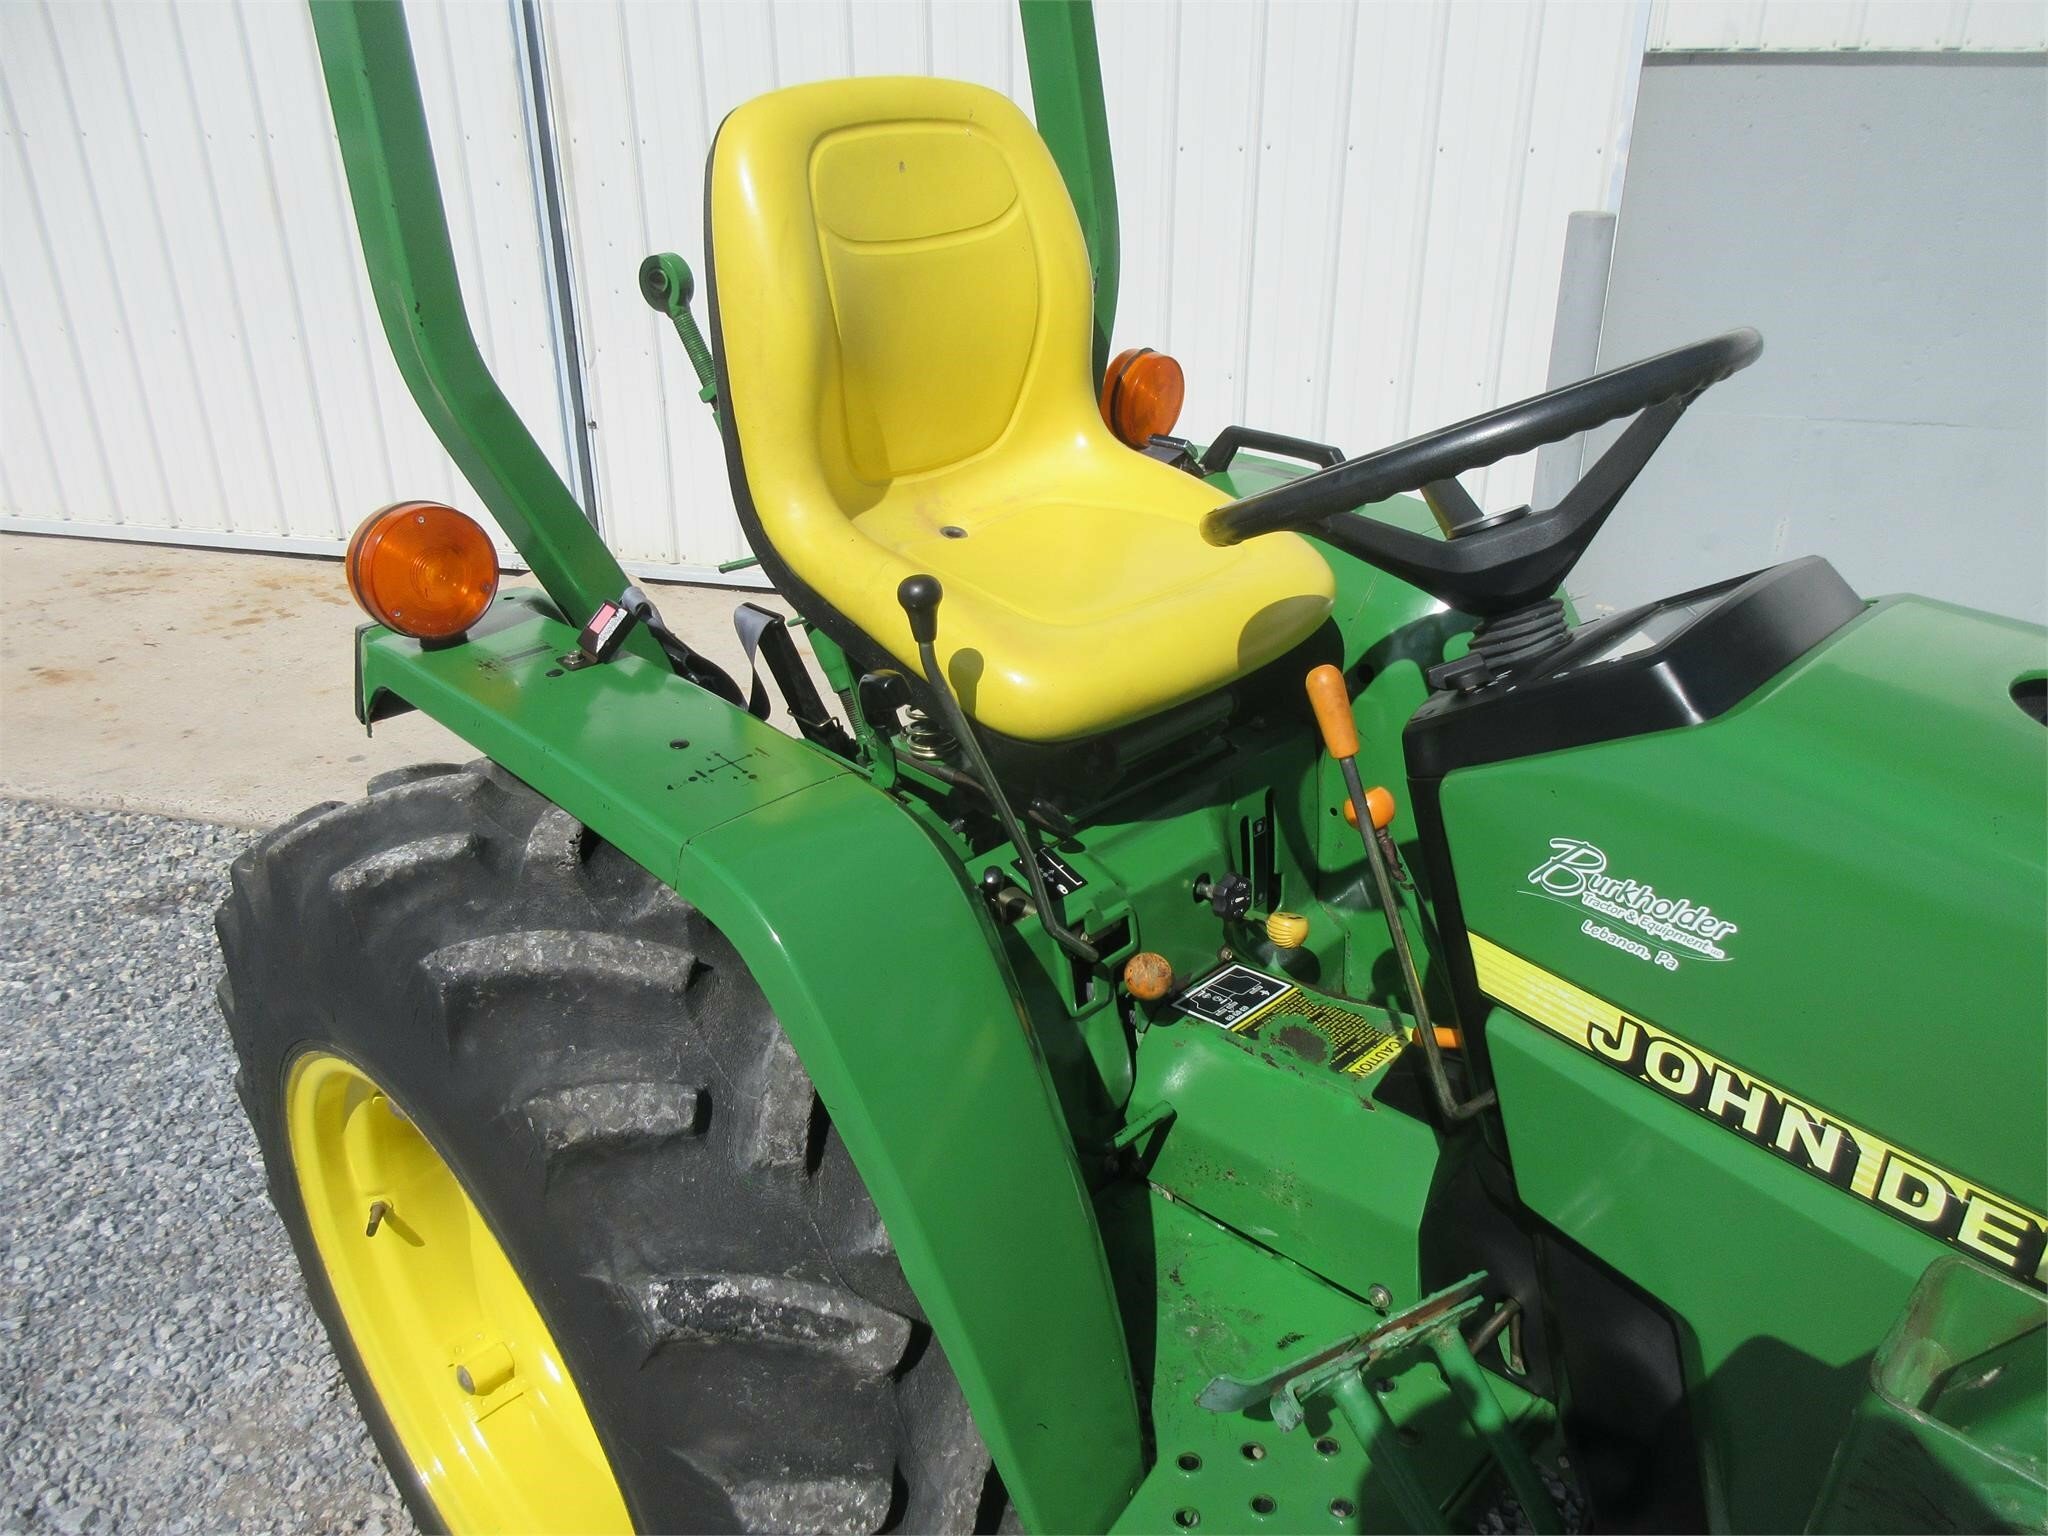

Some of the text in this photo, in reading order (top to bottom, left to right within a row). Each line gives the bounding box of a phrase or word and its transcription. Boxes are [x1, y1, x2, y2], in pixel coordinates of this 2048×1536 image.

[1528, 837, 1737, 940] Burkholder
[1581, 919, 1678, 971] Lebanon, Pa
[1582, 891, 1627, 918] Tractor
[1625, 909, 1639, 925] &
[1639, 914, 1712, 954] Equipment
[1354, 1040, 1402, 1077] CAUTION
[1588, 1018, 2048, 1281] JOHN DE
